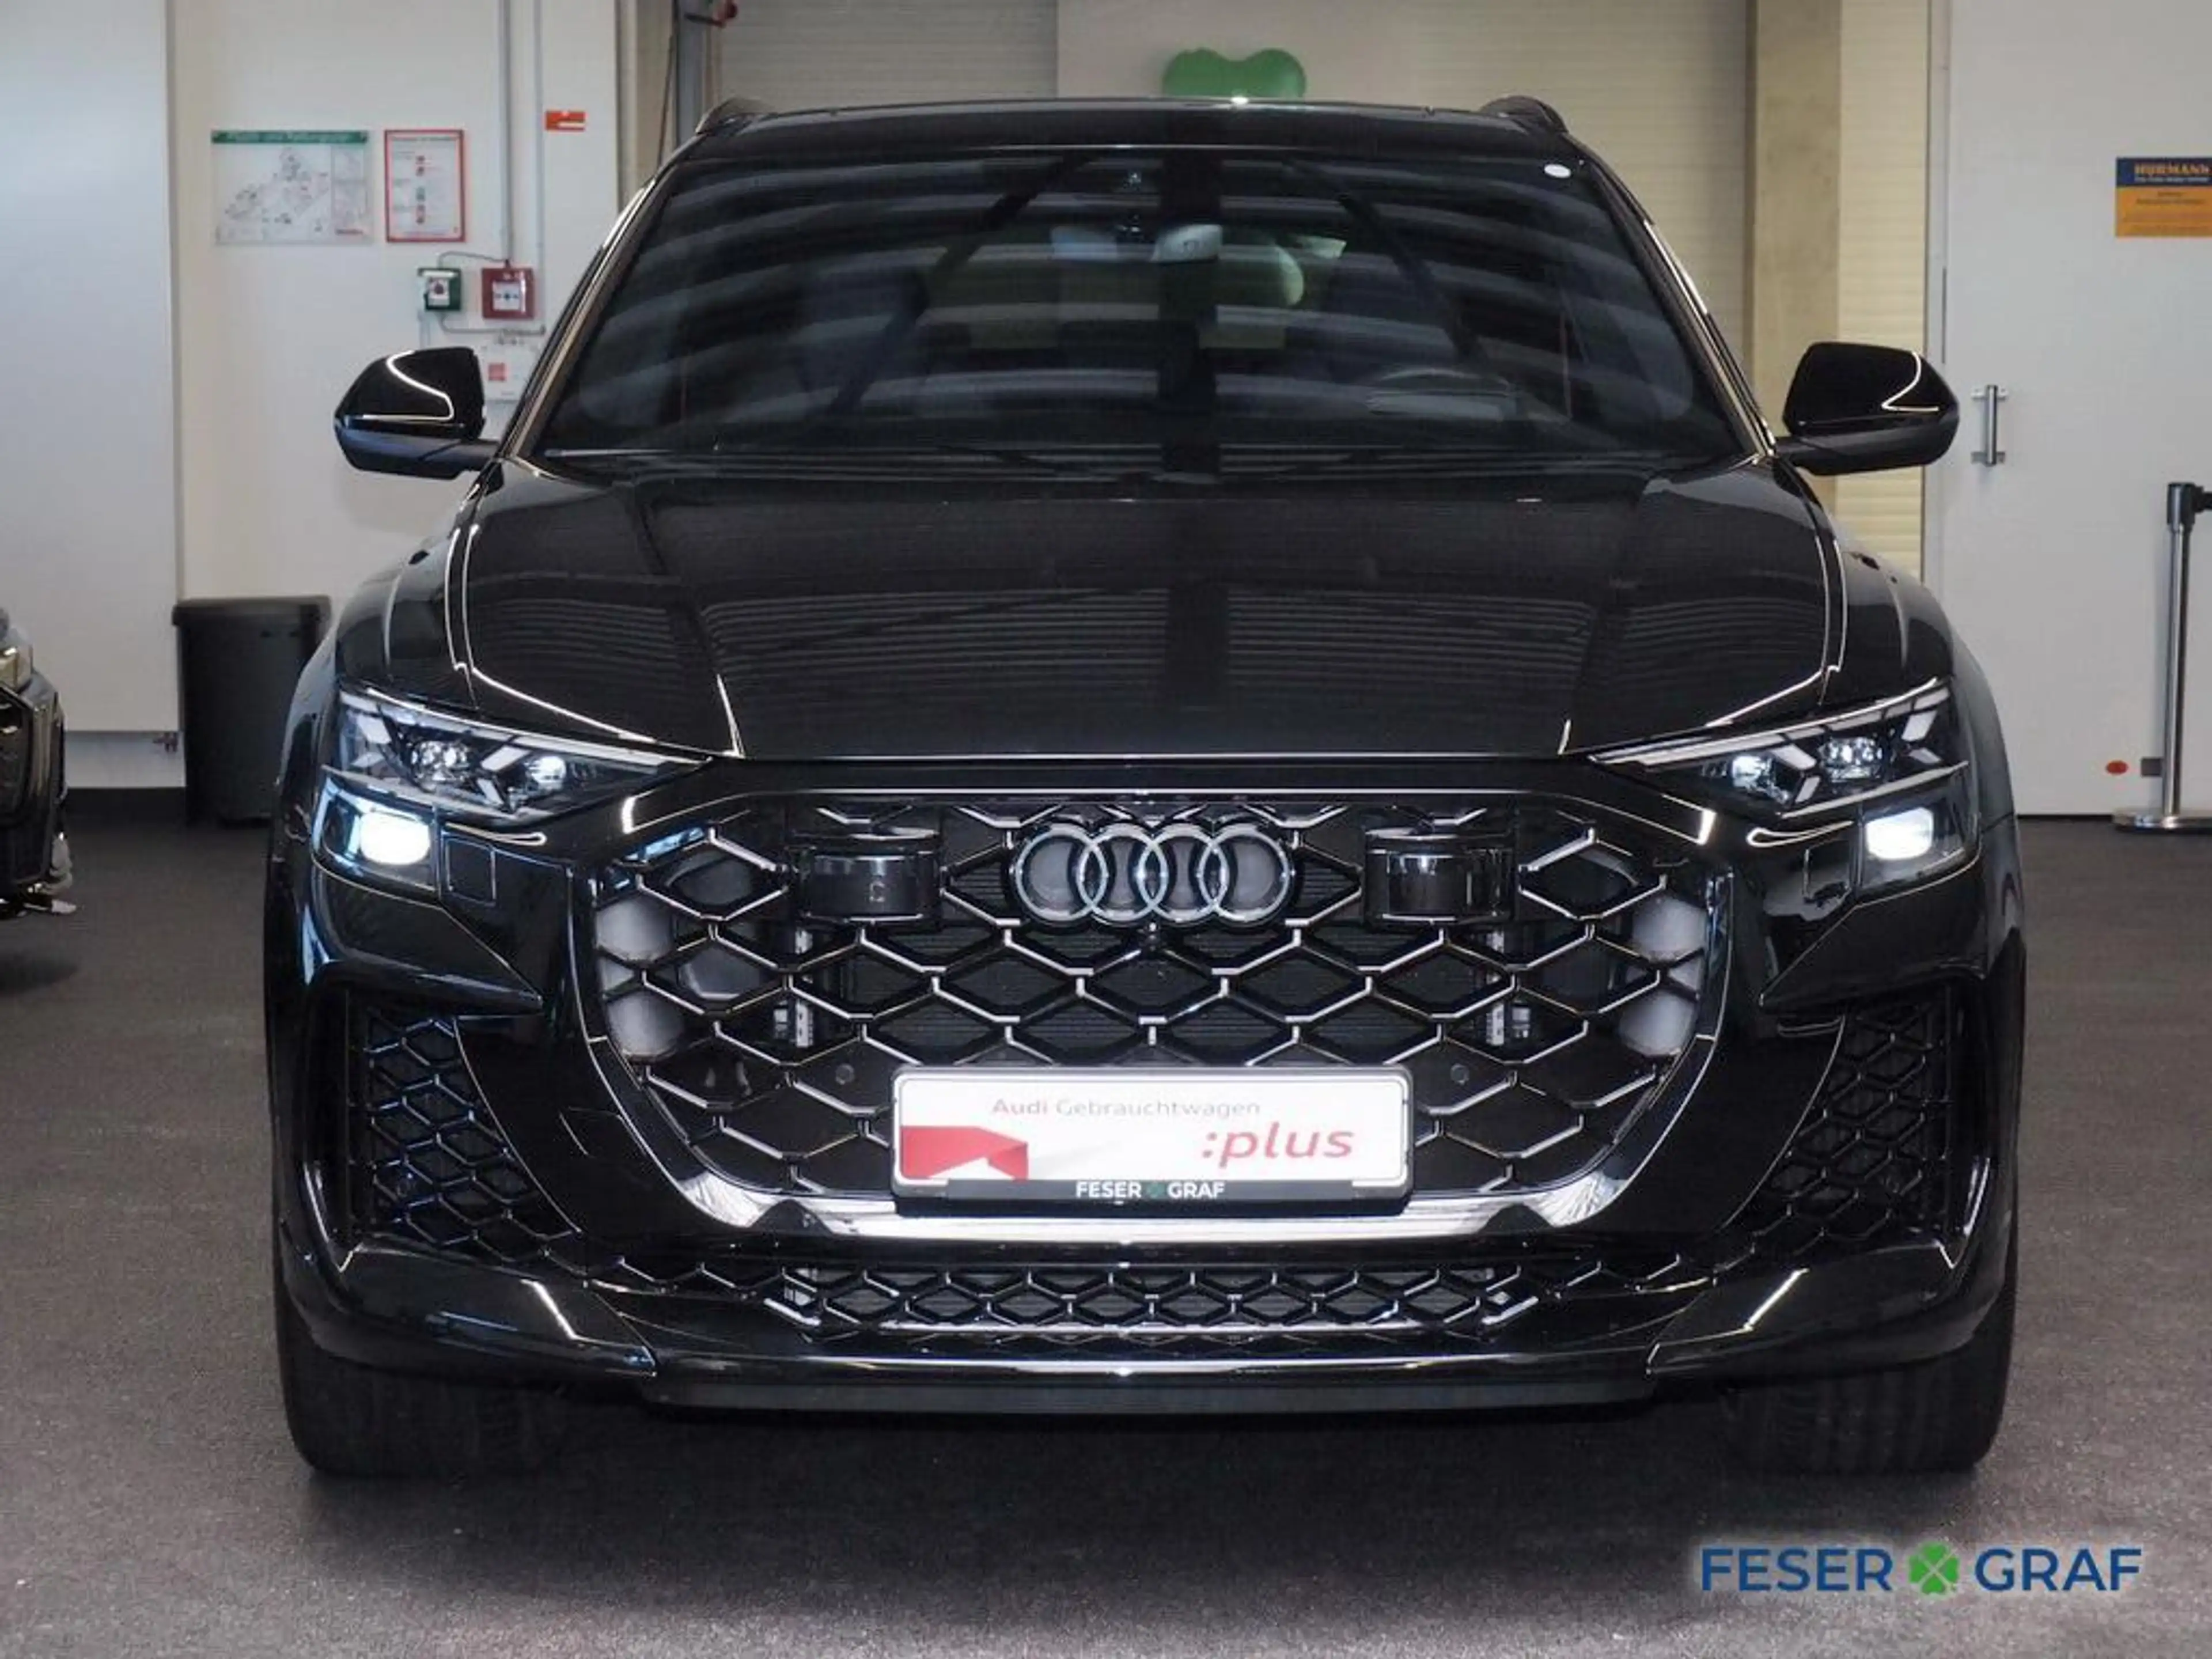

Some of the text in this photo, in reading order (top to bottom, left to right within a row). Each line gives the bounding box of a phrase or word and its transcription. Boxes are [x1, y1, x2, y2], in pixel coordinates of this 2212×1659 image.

[993, 1099, 1260, 1118] Audi Gebrauchtwagen
[1202, 1120, 1354, 1168] :plus
[1075, 1181, 1225, 1199] FESER GRAF
